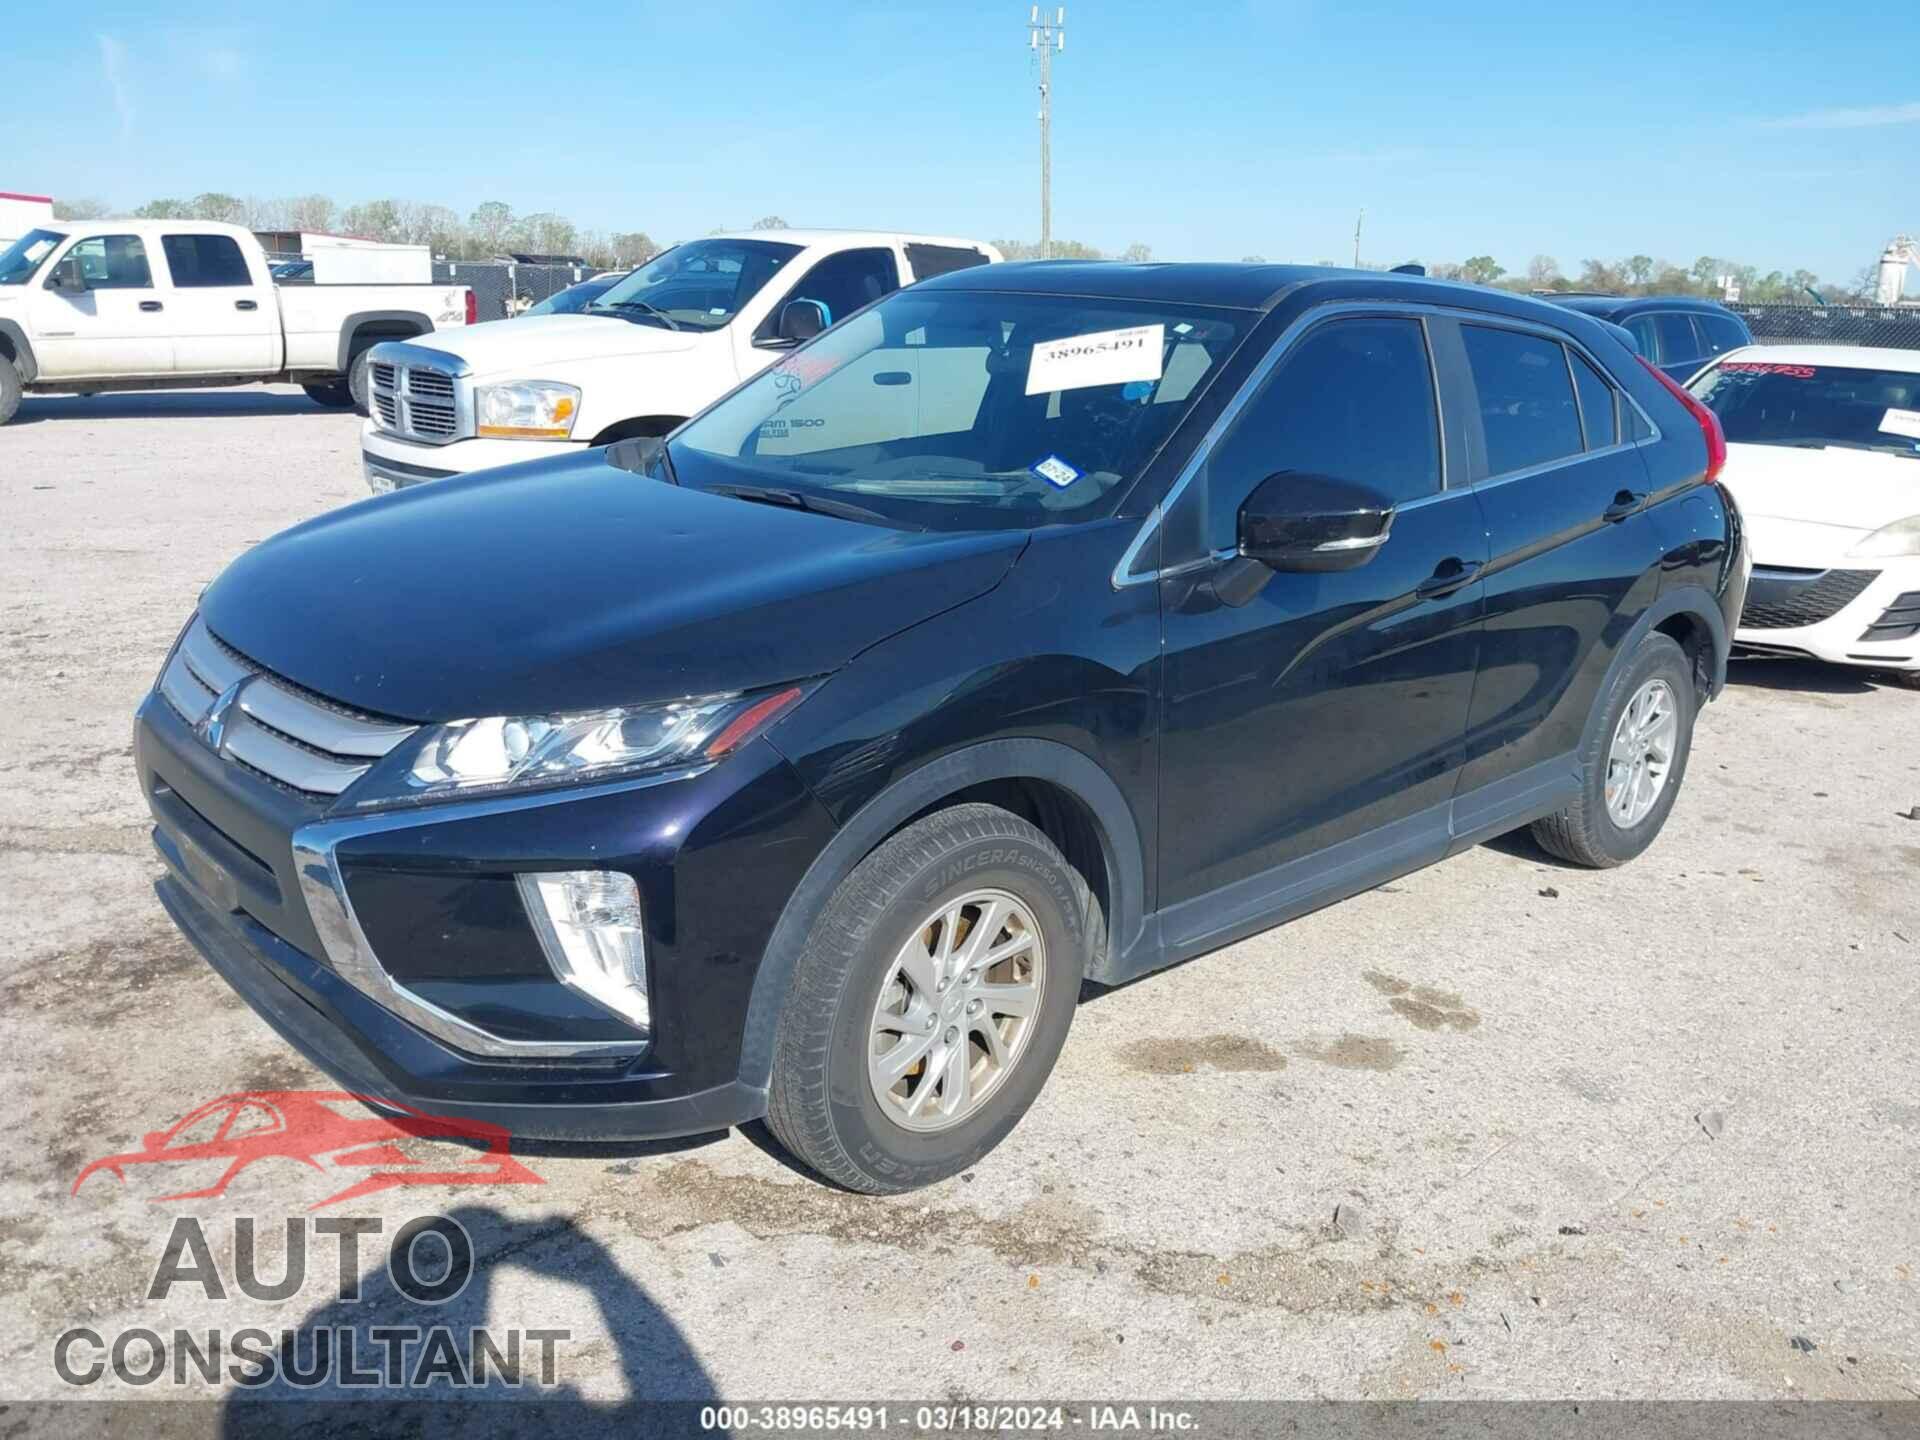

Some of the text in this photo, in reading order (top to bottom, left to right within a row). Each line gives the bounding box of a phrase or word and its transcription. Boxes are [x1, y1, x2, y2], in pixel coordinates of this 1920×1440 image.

[1044, 338, 1144, 363] 38965491
[790, 418, 825, 428] 1500
[924, 848, 1020, 897] SINCERA
